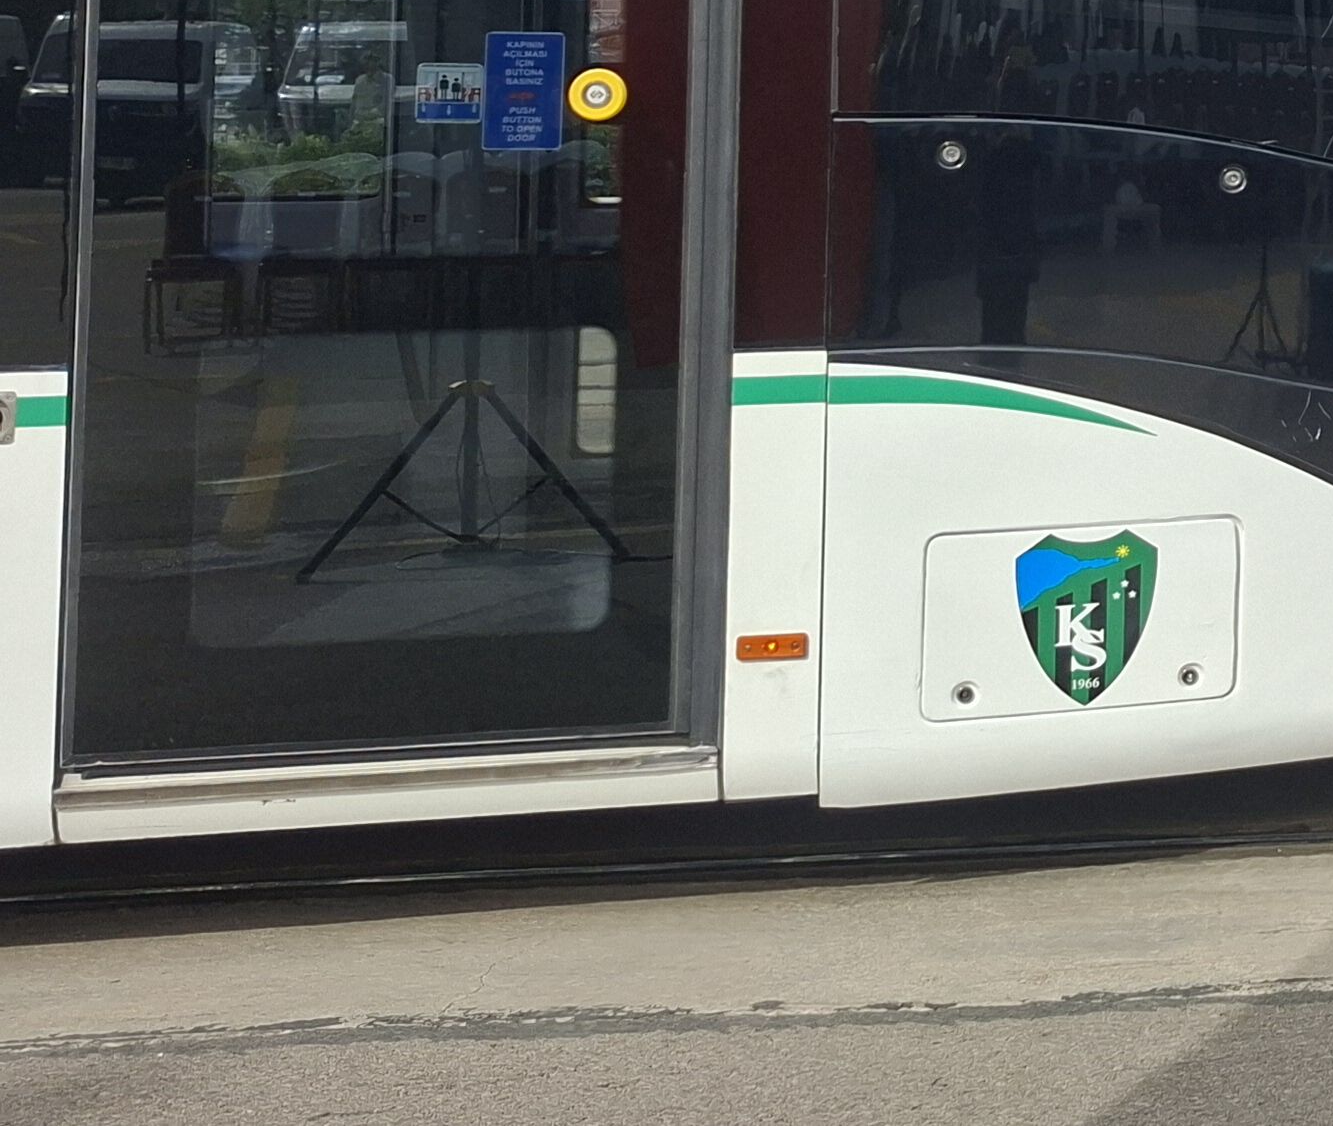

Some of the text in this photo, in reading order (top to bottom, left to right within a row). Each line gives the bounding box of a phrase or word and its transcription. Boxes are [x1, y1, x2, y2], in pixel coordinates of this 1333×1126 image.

[509, 106, 536, 114] PUSH
[501, 125, 543, 133] TO OPEN
[507, 134, 536, 142] DOOR
[1054, 602, 1107, 672] KS
[1071, 677, 1100, 691] 1966
